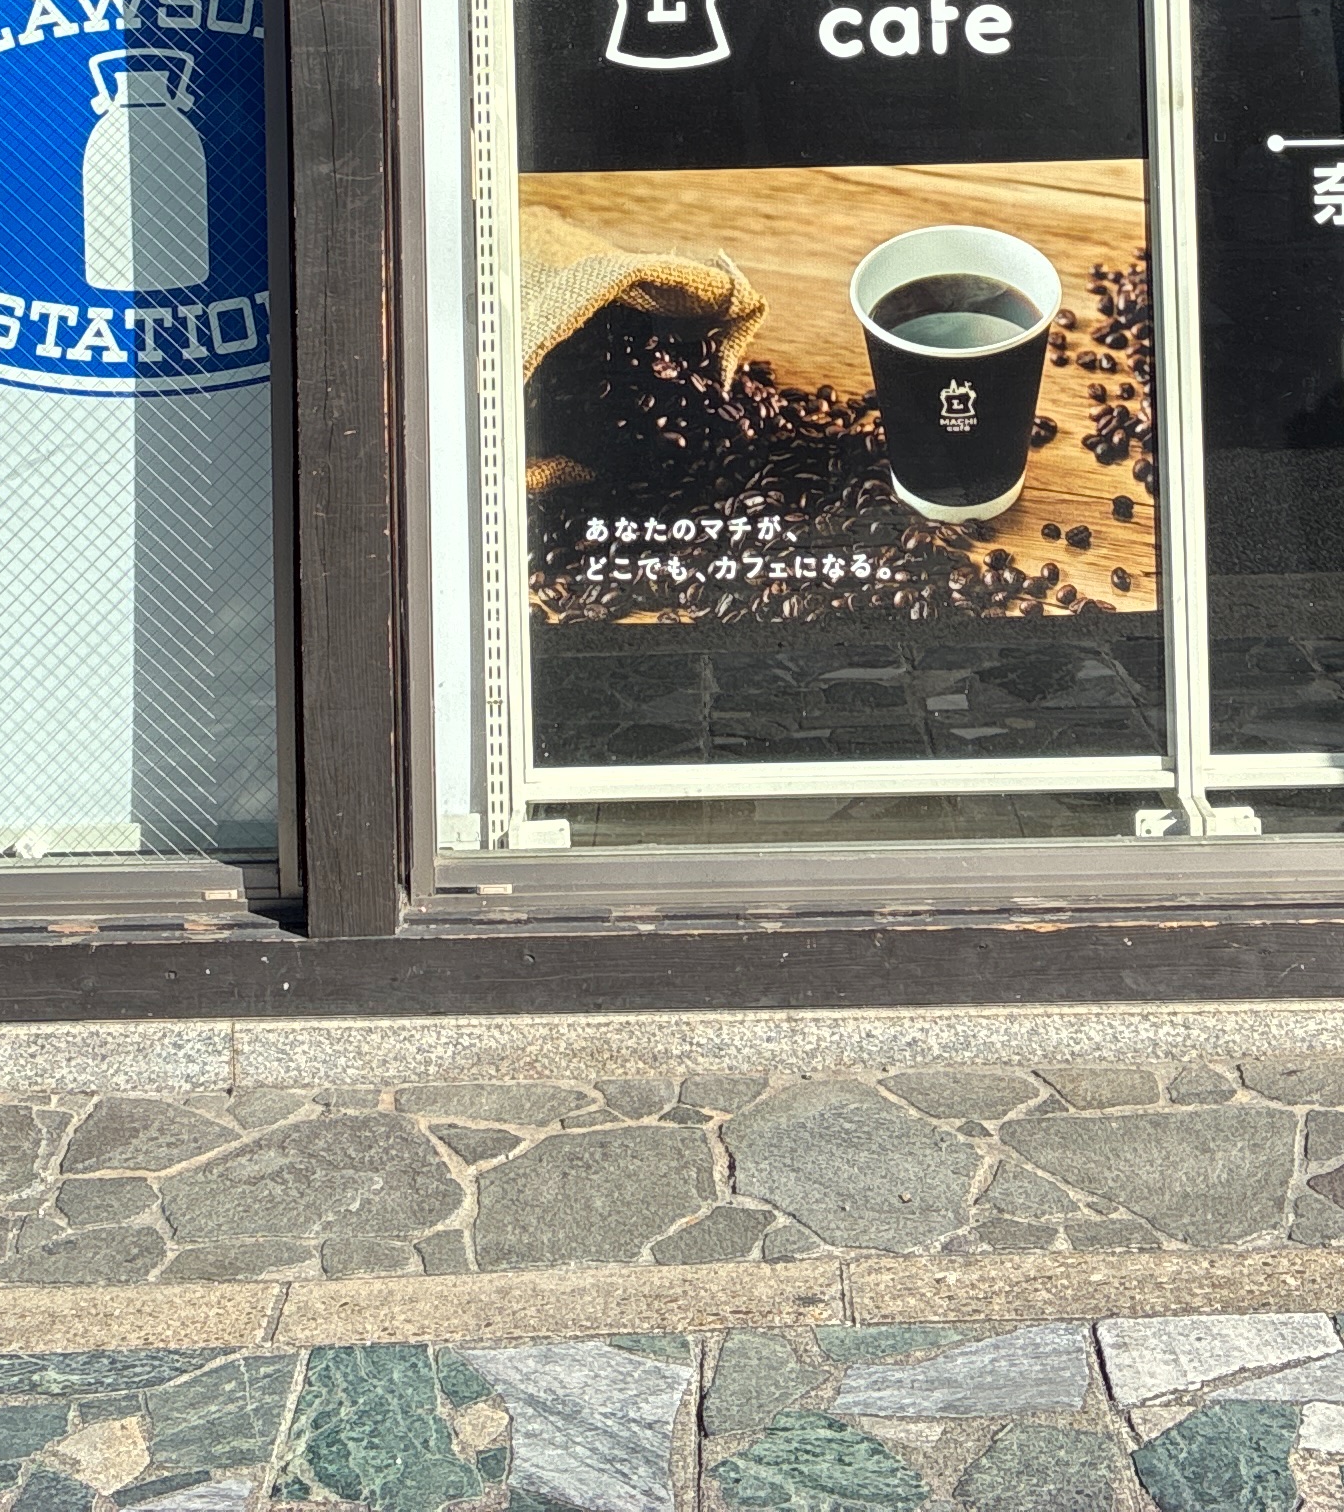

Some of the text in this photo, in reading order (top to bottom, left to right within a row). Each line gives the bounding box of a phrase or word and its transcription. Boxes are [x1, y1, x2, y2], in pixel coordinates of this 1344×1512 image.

[939, 418, 977, 426] MACHI
[586, 516, 798, 542] あなたのマチが、
[586, 554, 892, 582] どこでも、カフェになる。
